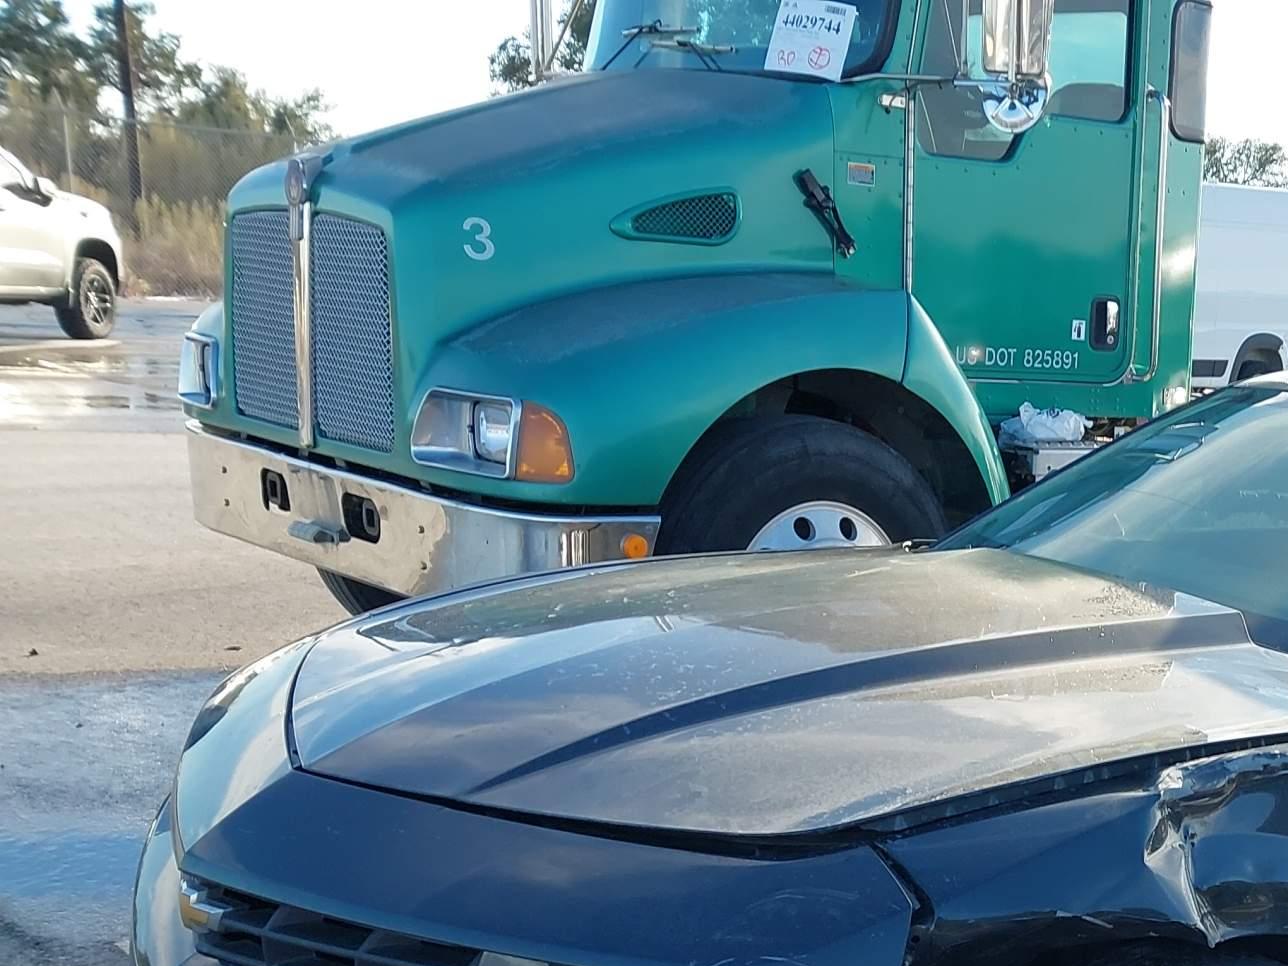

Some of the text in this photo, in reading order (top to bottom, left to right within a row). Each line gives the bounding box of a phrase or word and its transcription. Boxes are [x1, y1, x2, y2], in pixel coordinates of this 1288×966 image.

[782, 13, 842, 36] 44029744
[462, 216, 496, 261] 3
[955, 346, 1080, 370] US DOT 825891
